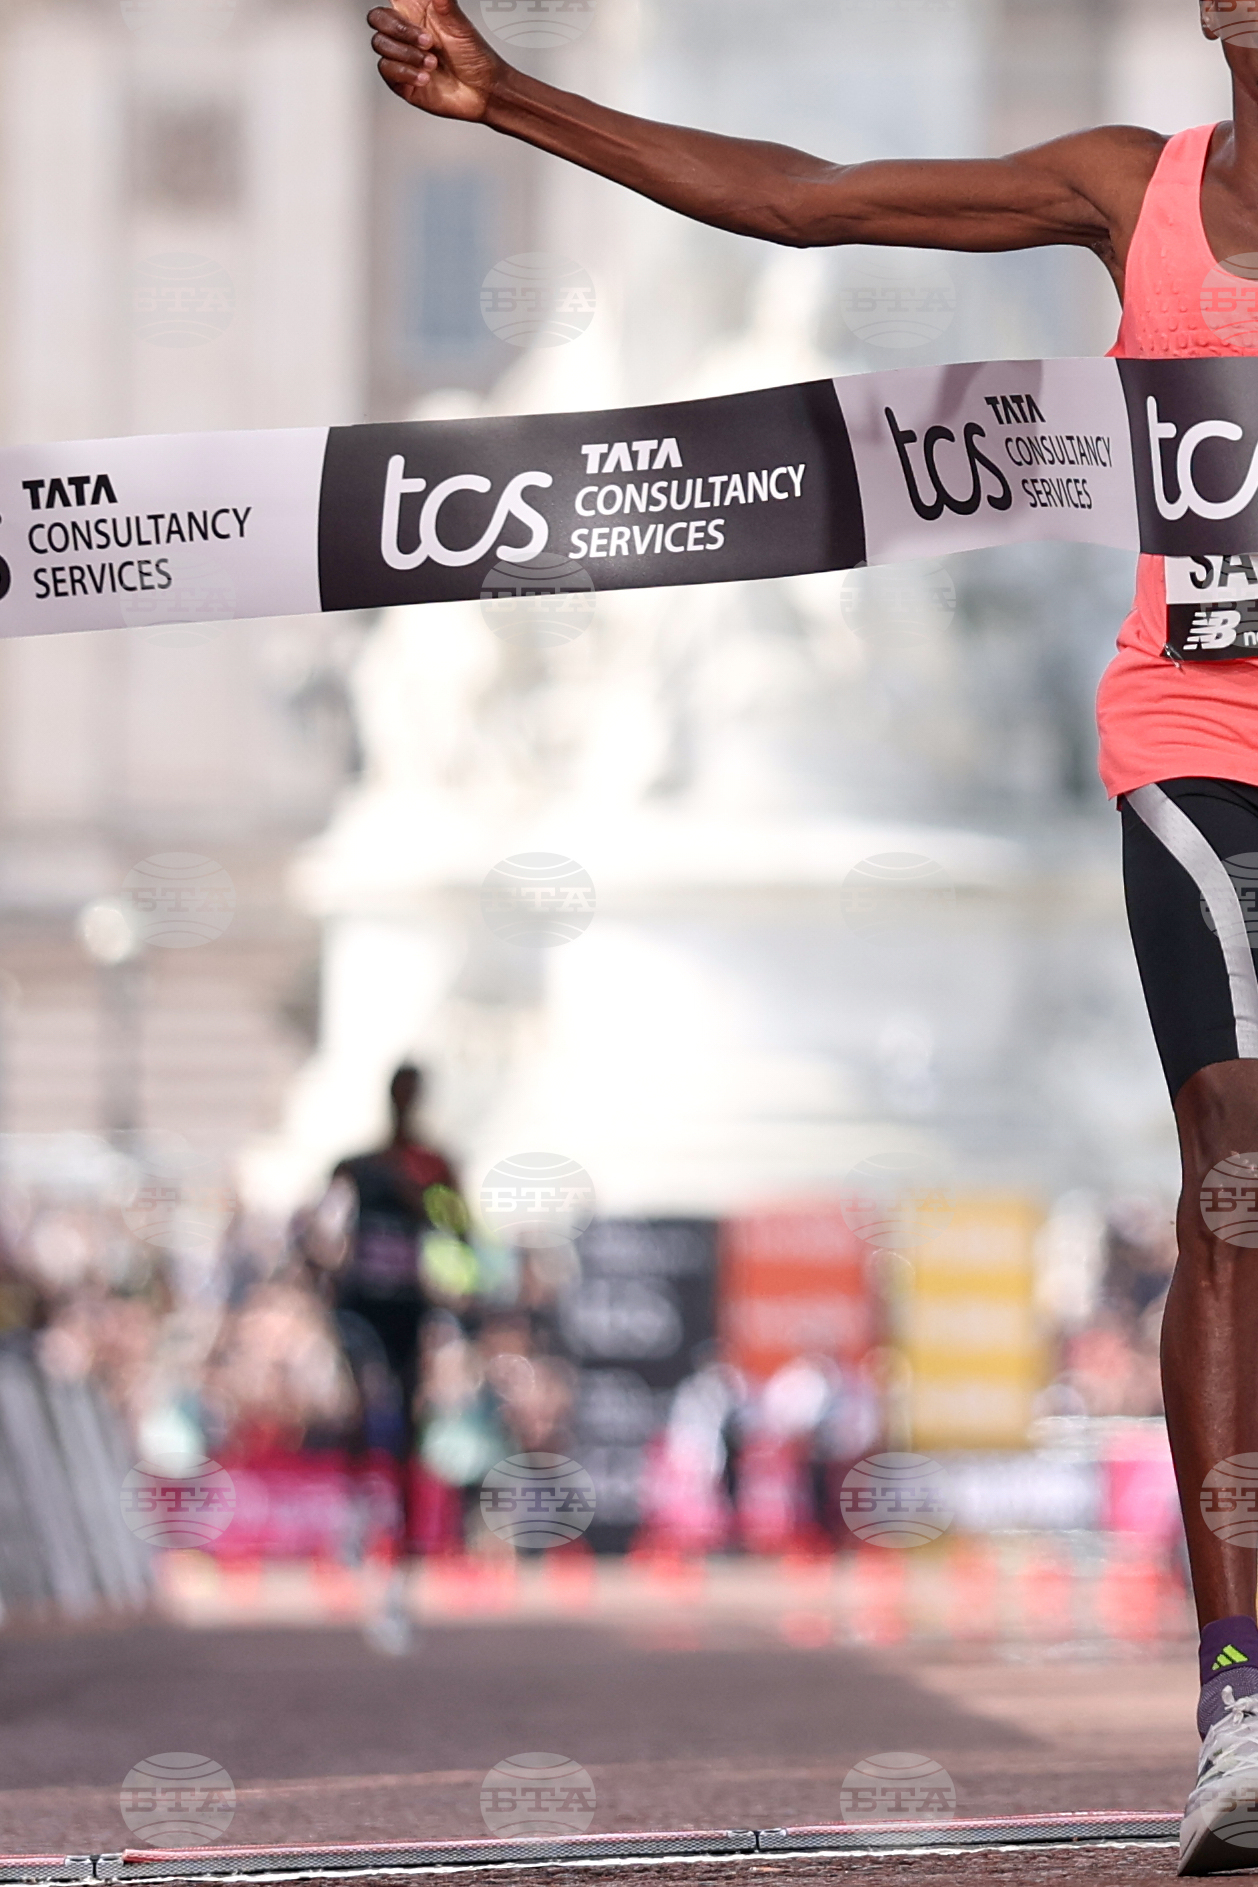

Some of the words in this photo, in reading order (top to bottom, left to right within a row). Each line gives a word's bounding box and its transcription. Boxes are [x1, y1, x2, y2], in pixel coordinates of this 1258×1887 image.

[984, 394, 1046, 425] TATA
[581, 437, 683, 471] TATA
[884, 406, 1013, 521] tcs
[1004, 435, 1112, 468] CONSULTANCY
[22, 474, 117, 510] TATA
[573, 464, 806, 518] CONSULTANCY
[1020, 477, 1093, 510] SERVICES
[28, 506, 252, 555] CONSULTANCY
[380, 454, 553, 570] tcs
[568, 519, 725, 560] SERVICES
[33, 558, 172, 600] SERVICES
